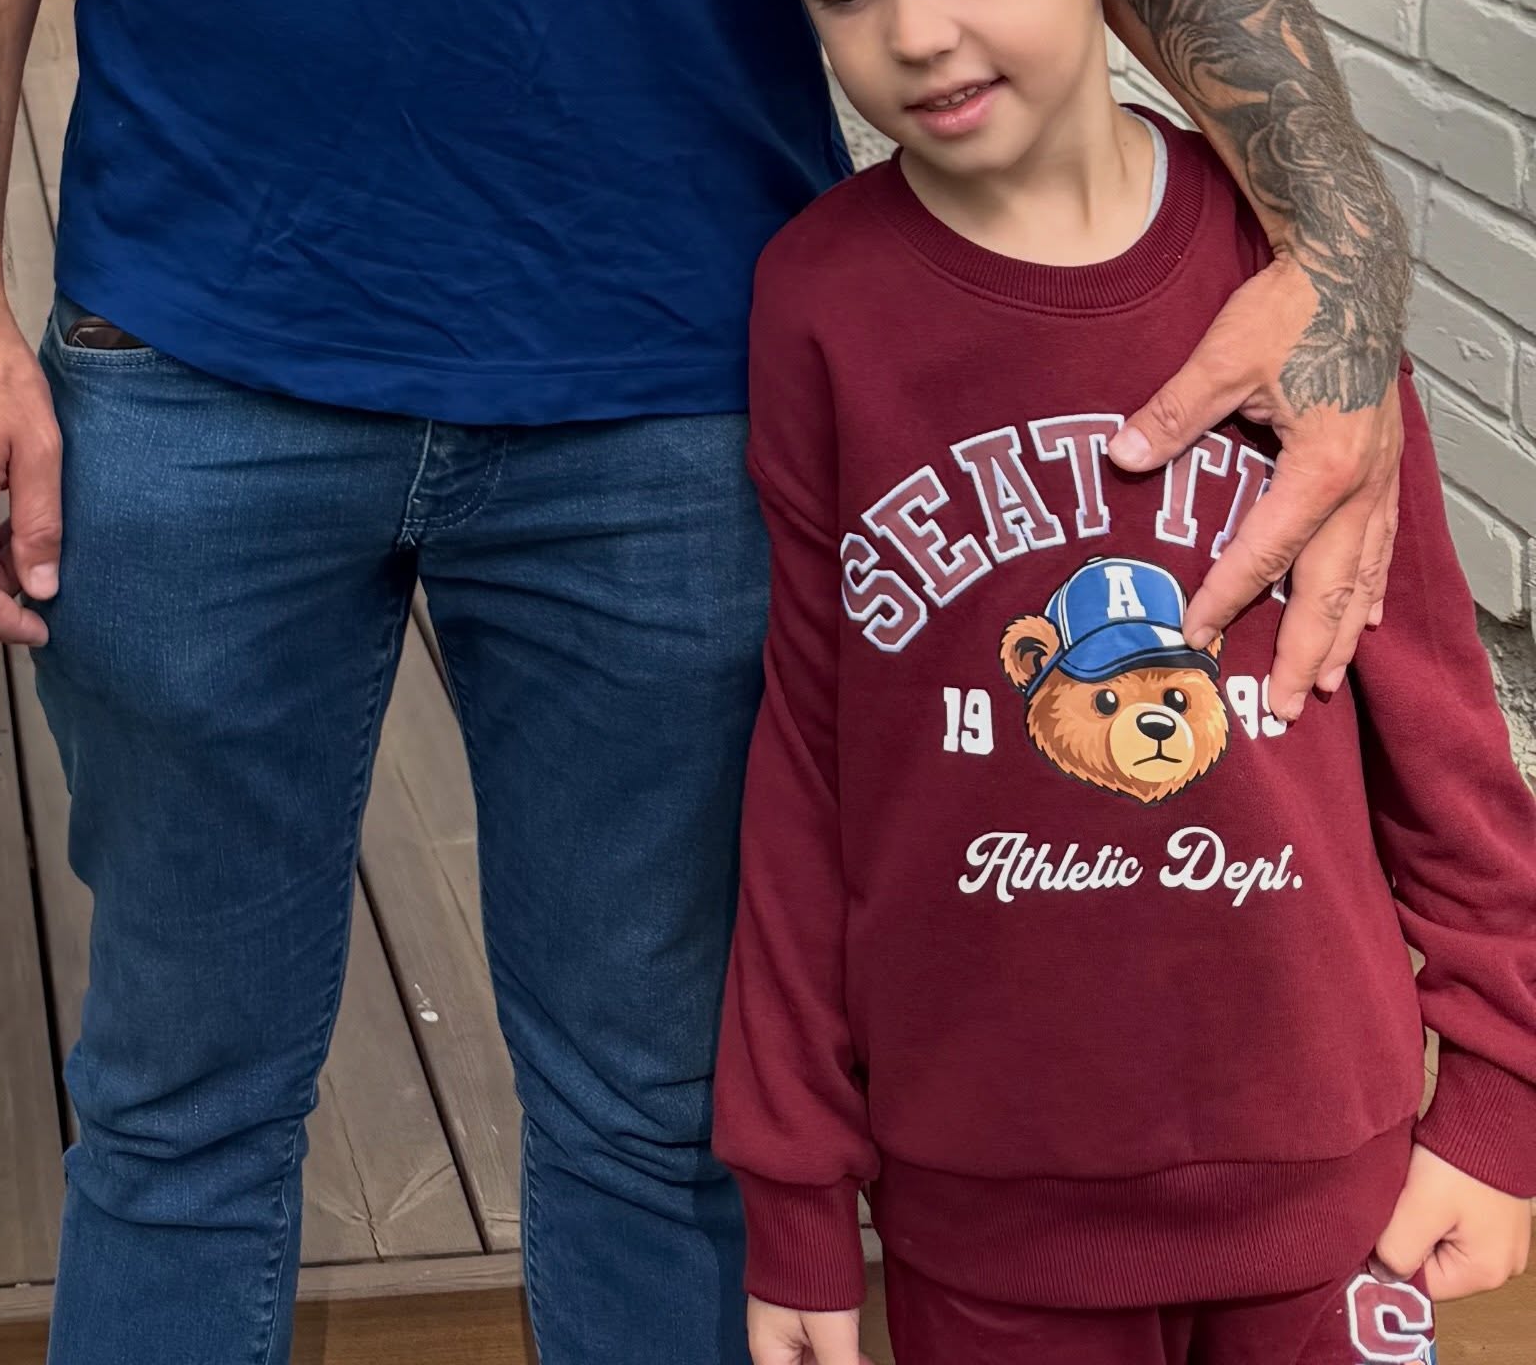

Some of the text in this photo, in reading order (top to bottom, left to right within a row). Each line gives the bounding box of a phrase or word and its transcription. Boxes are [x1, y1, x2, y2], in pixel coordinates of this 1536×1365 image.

[840, 412, 1288, 653] SEATT
[1104, 565, 1147, 619] A
[942, 686, 995, 756] 19
[957, 825, 1304, 908] Athletic Dept.
